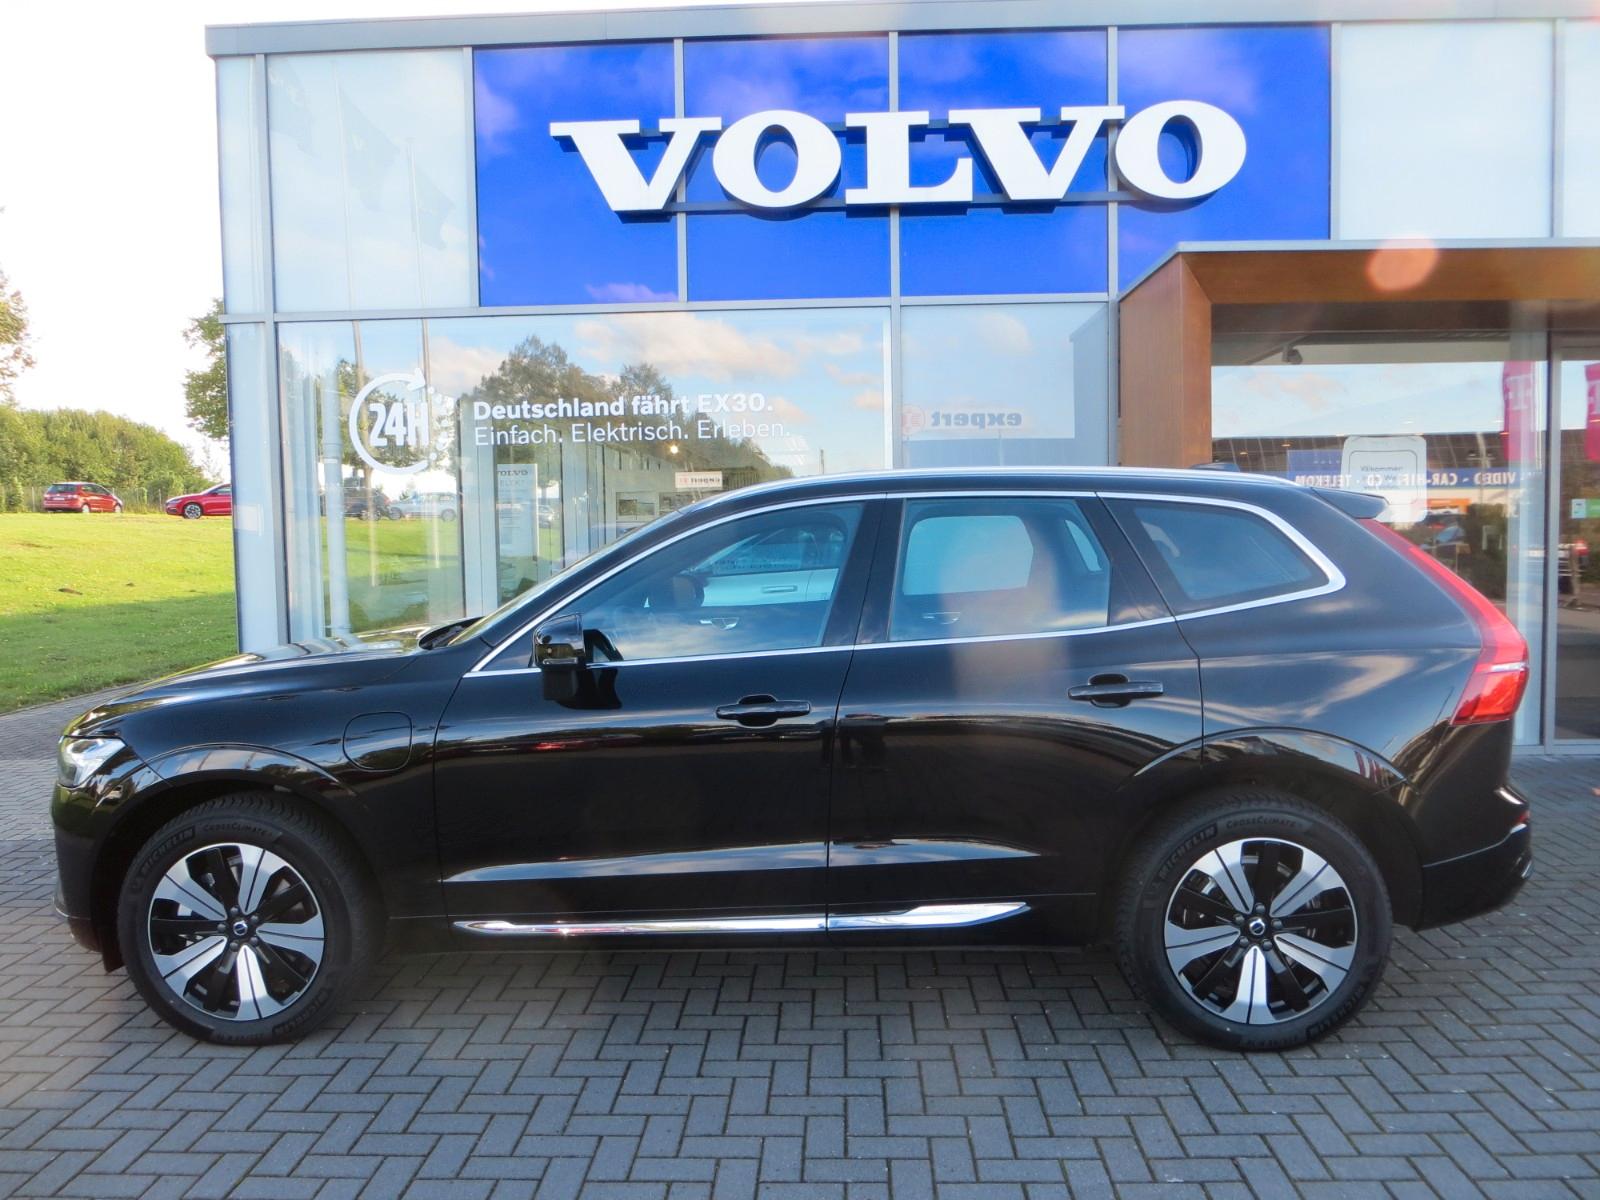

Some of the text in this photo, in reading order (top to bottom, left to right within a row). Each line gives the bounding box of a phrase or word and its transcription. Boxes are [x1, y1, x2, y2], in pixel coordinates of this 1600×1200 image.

[549, 100, 1247, 212] VOLVO
[369, 402, 429, 447] 24H
[473, 392, 773, 420] Deutschland fährt EX30.
[474, 419, 790, 446] Einfach. Elektrisch. Erleben.
[142, 825, 196, 876] MICHELIN
[1156, 823, 1217, 882] MICHELIN
